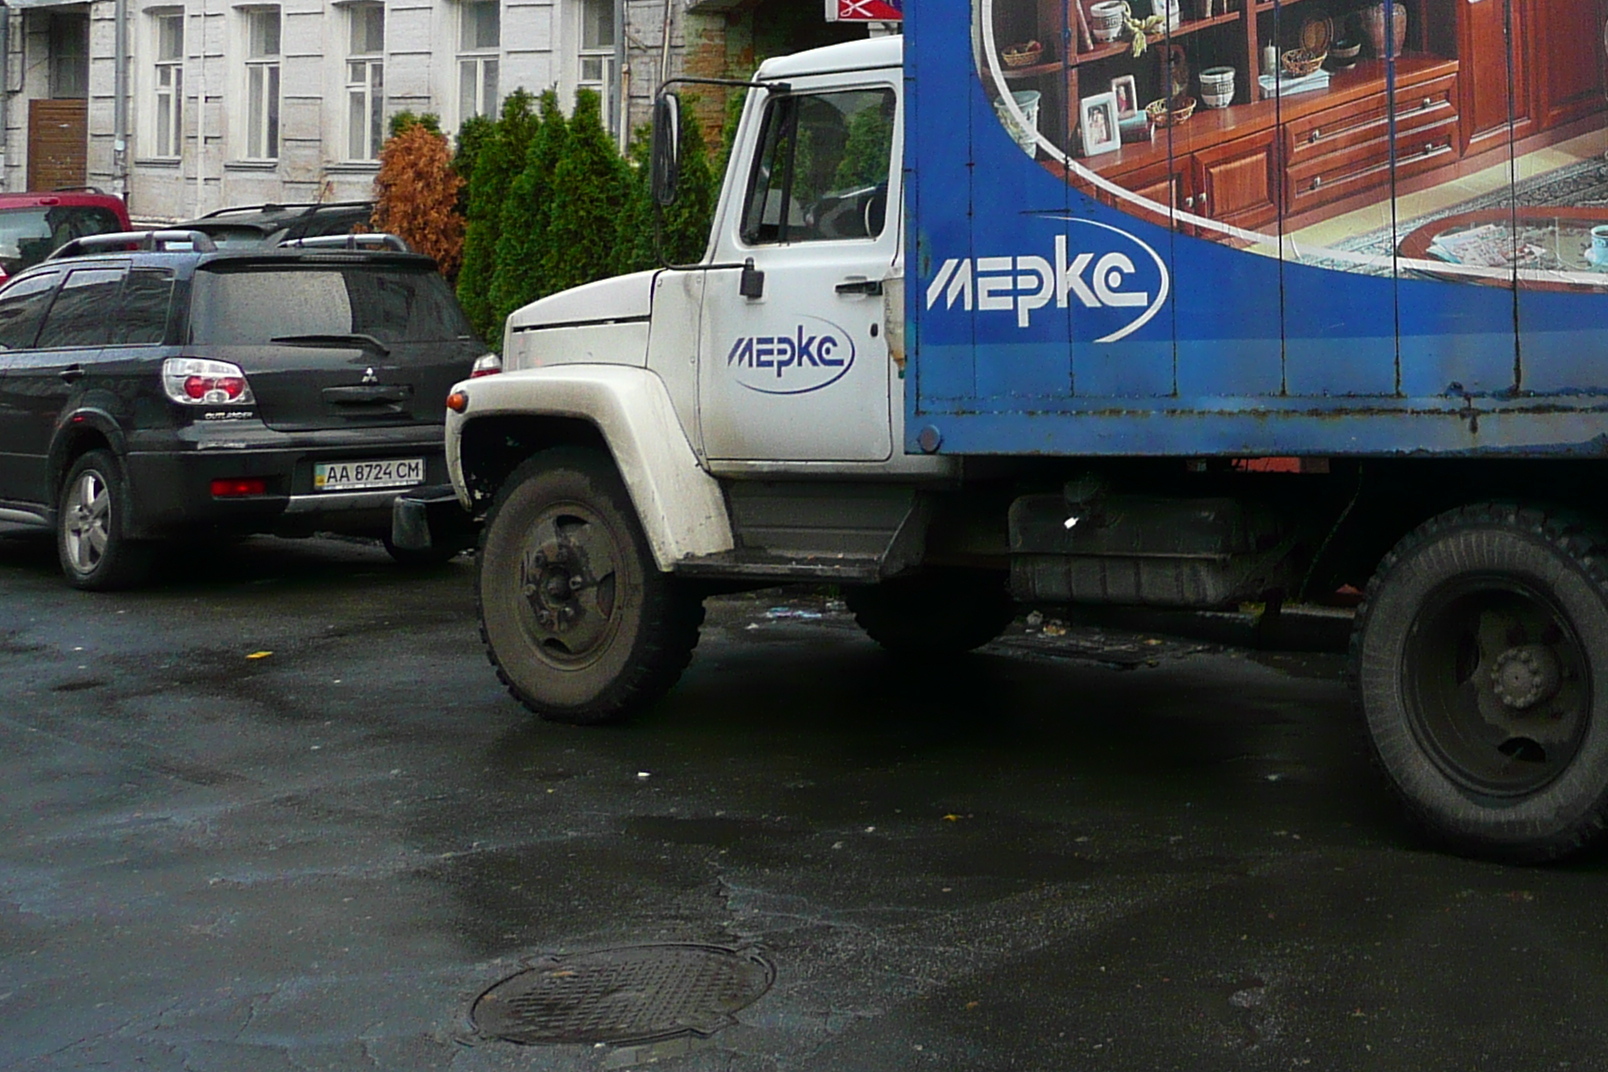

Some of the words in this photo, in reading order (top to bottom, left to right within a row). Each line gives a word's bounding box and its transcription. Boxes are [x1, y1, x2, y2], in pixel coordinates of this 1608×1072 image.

[205, 411, 253, 420] OUTLANDER
[326, 465, 351, 483] AA
[355, 462, 392, 481] 8724
[396, 461, 420, 479] CM
